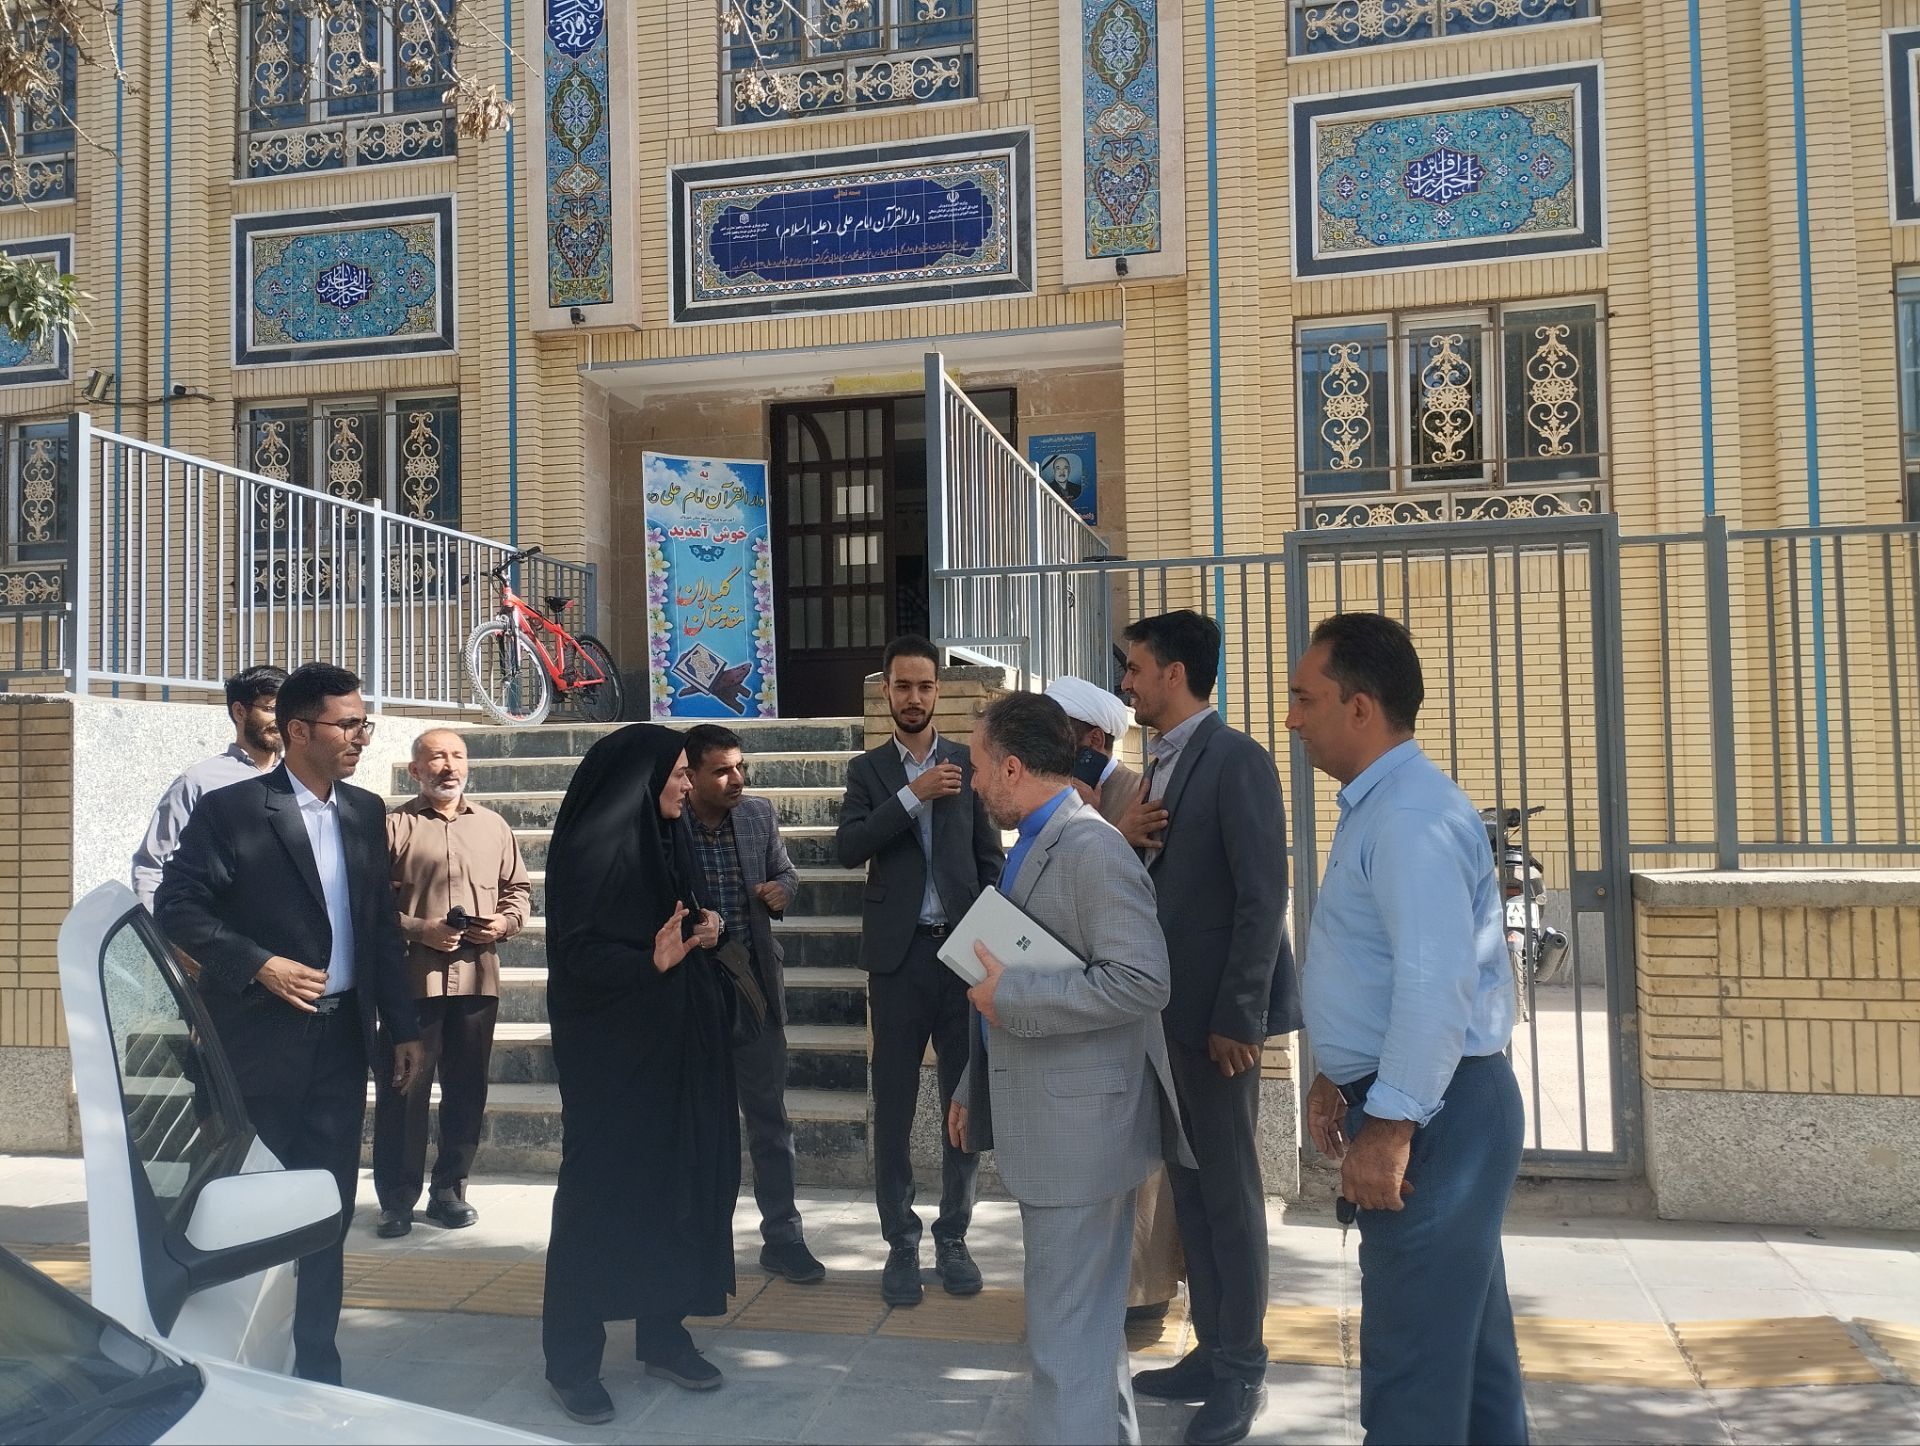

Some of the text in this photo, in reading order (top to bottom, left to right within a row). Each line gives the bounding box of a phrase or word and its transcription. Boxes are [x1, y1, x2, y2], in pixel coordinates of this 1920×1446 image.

[837, 213, 853, 236] علی
[854, 215, 873, 243] امام
[699, 469, 709, 481] به
[659, 482, 682, 506] علی
[682, 486, 705, 515] امام
[669, 523, 747, 543] خوش آمدید
[683, 602, 745, 636] مقدمتان
